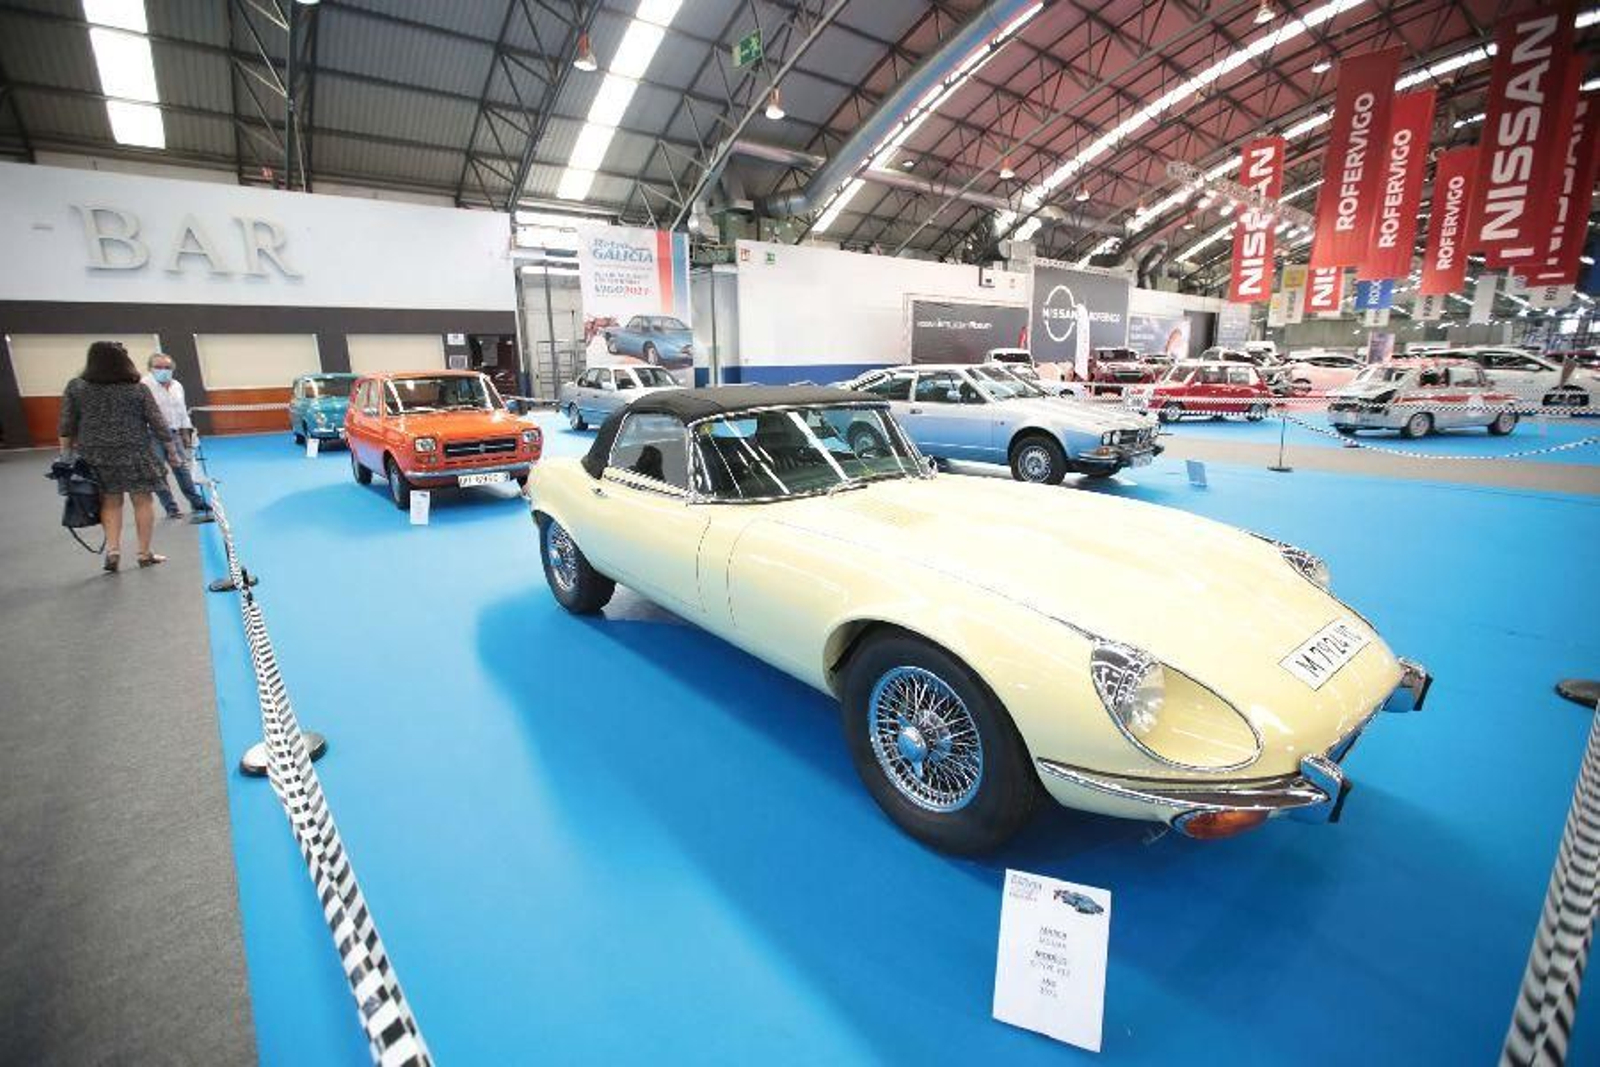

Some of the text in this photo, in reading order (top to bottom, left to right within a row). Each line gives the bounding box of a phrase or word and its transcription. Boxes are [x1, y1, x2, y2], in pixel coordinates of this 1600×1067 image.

[1336, 92, 1375, 232] ROFERVIGO
[1480, 13, 1559, 241] NISSAN
[1379, 128, 1412, 248] ROFERVIGO
[1436, 175, 1466, 271] ROFERVIGO
[69, 201, 303, 282] BAR
[593, 248, 653, 263] GALICIA
[1042, 307, 1078, 320] NISSAN
